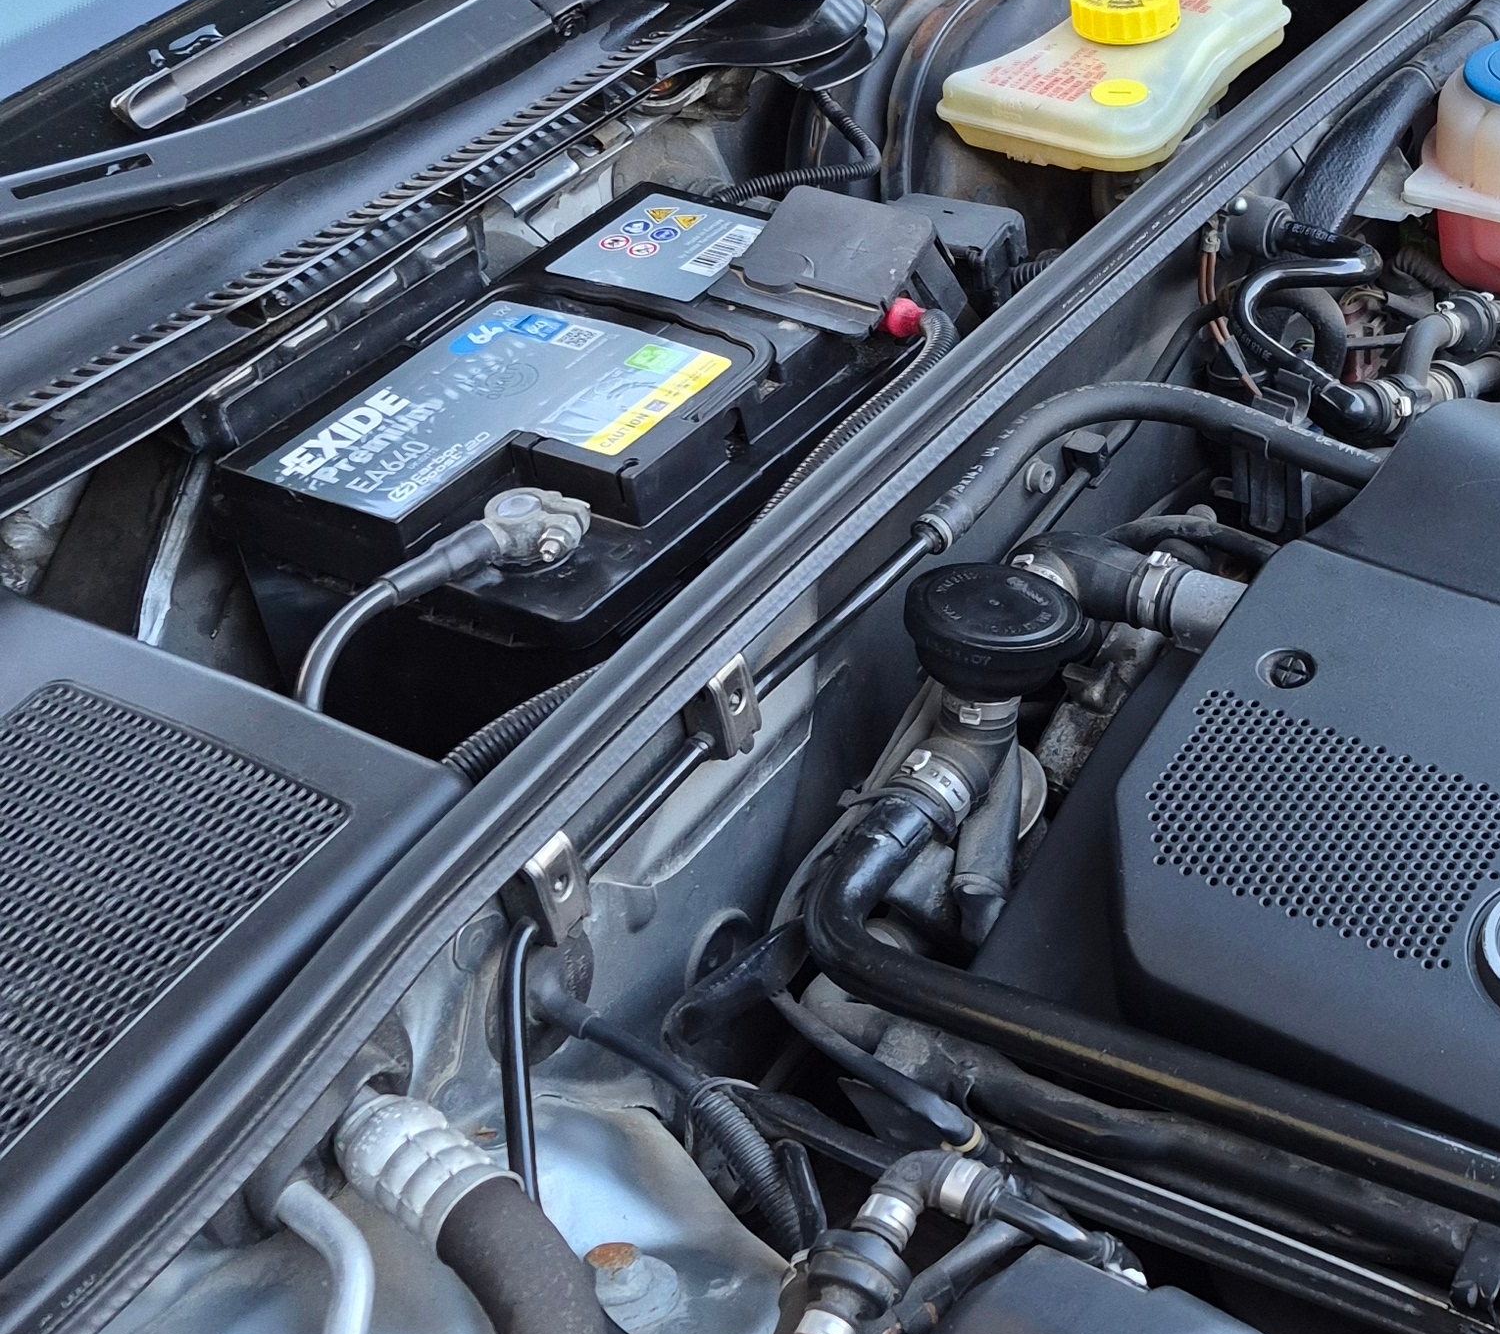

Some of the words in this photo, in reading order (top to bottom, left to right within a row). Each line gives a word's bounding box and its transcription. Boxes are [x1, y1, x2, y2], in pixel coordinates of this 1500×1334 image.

[493, 305, 512, 318] 12V
[467, 324, 505, 344] 64
[279, 386, 411, 477] EXIDE
[311, 398, 444, 484] Premium
[600, 412, 649, 448] CAUTION
[345, 440, 430, 494] EA640
[410, 443, 464, 481] carbon
[415, 451, 462, 486] boost
